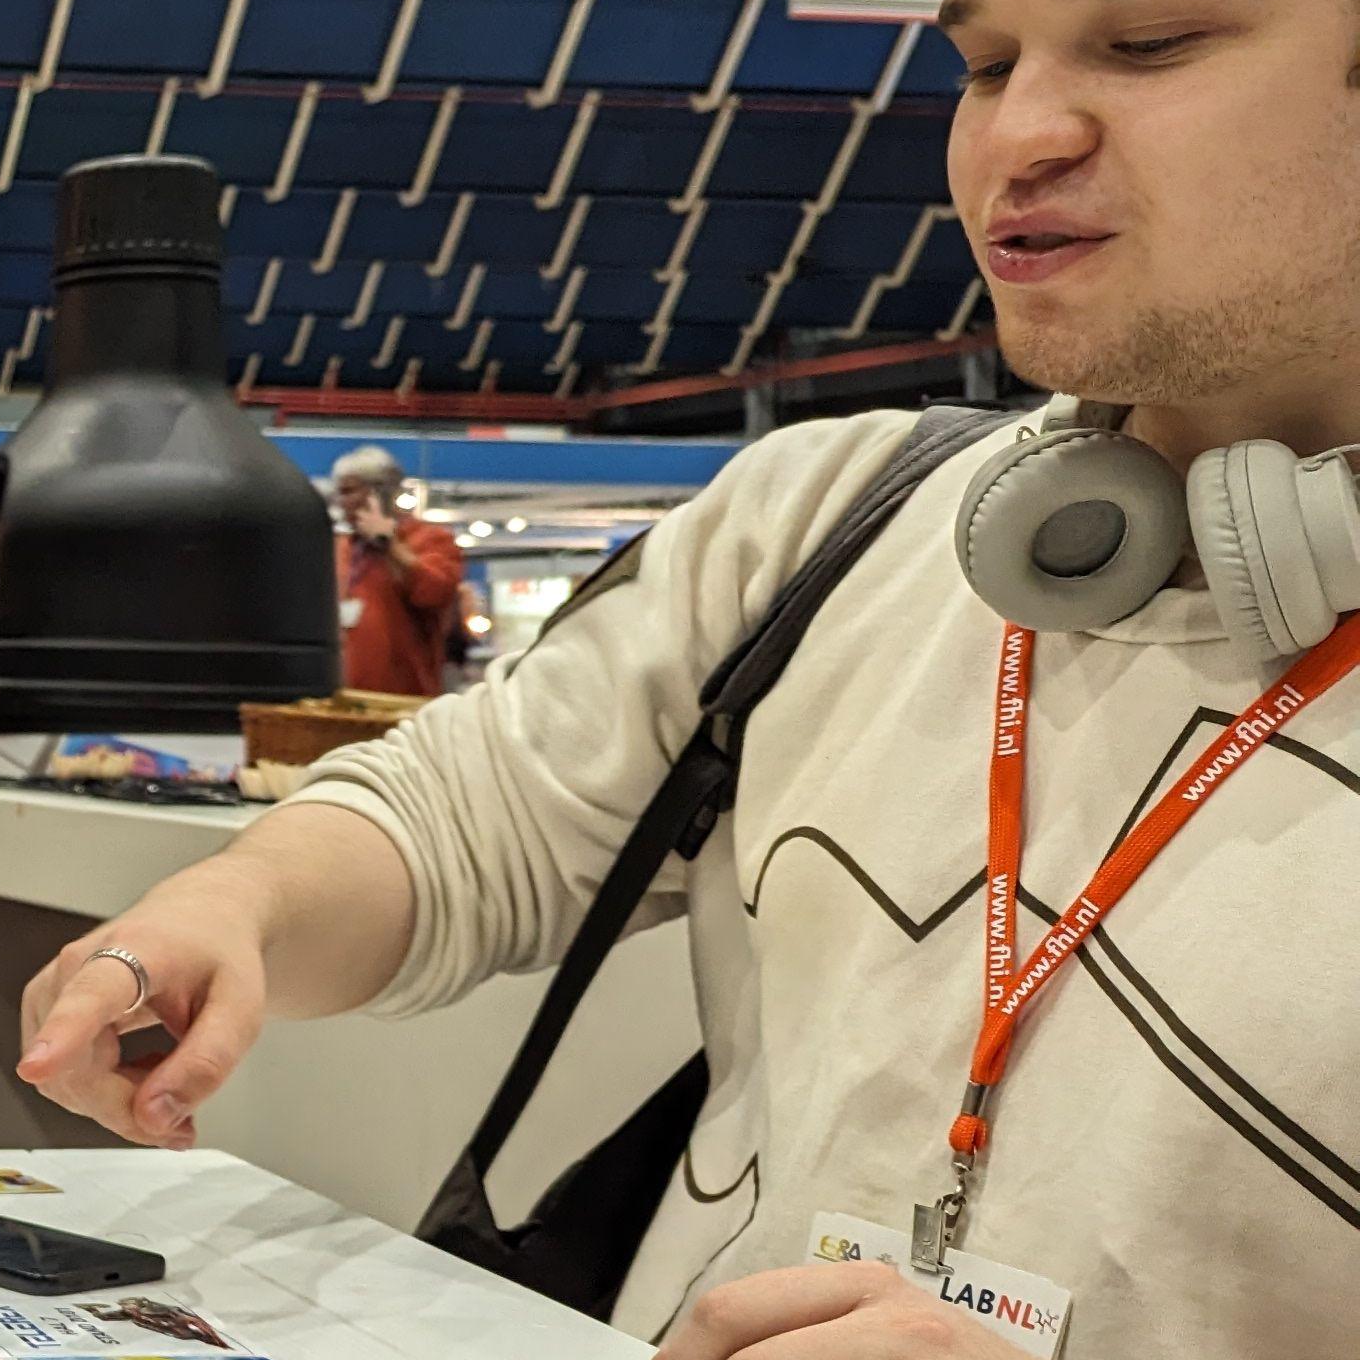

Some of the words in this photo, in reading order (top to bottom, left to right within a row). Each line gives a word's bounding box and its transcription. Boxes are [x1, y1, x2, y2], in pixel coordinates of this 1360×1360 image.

[996, 631, 1023, 757] www.fhi.nl
[1182, 683, 1305, 804] www.fhi.nl
[1000, 897, 1100, 1016] www.fhi.nl
